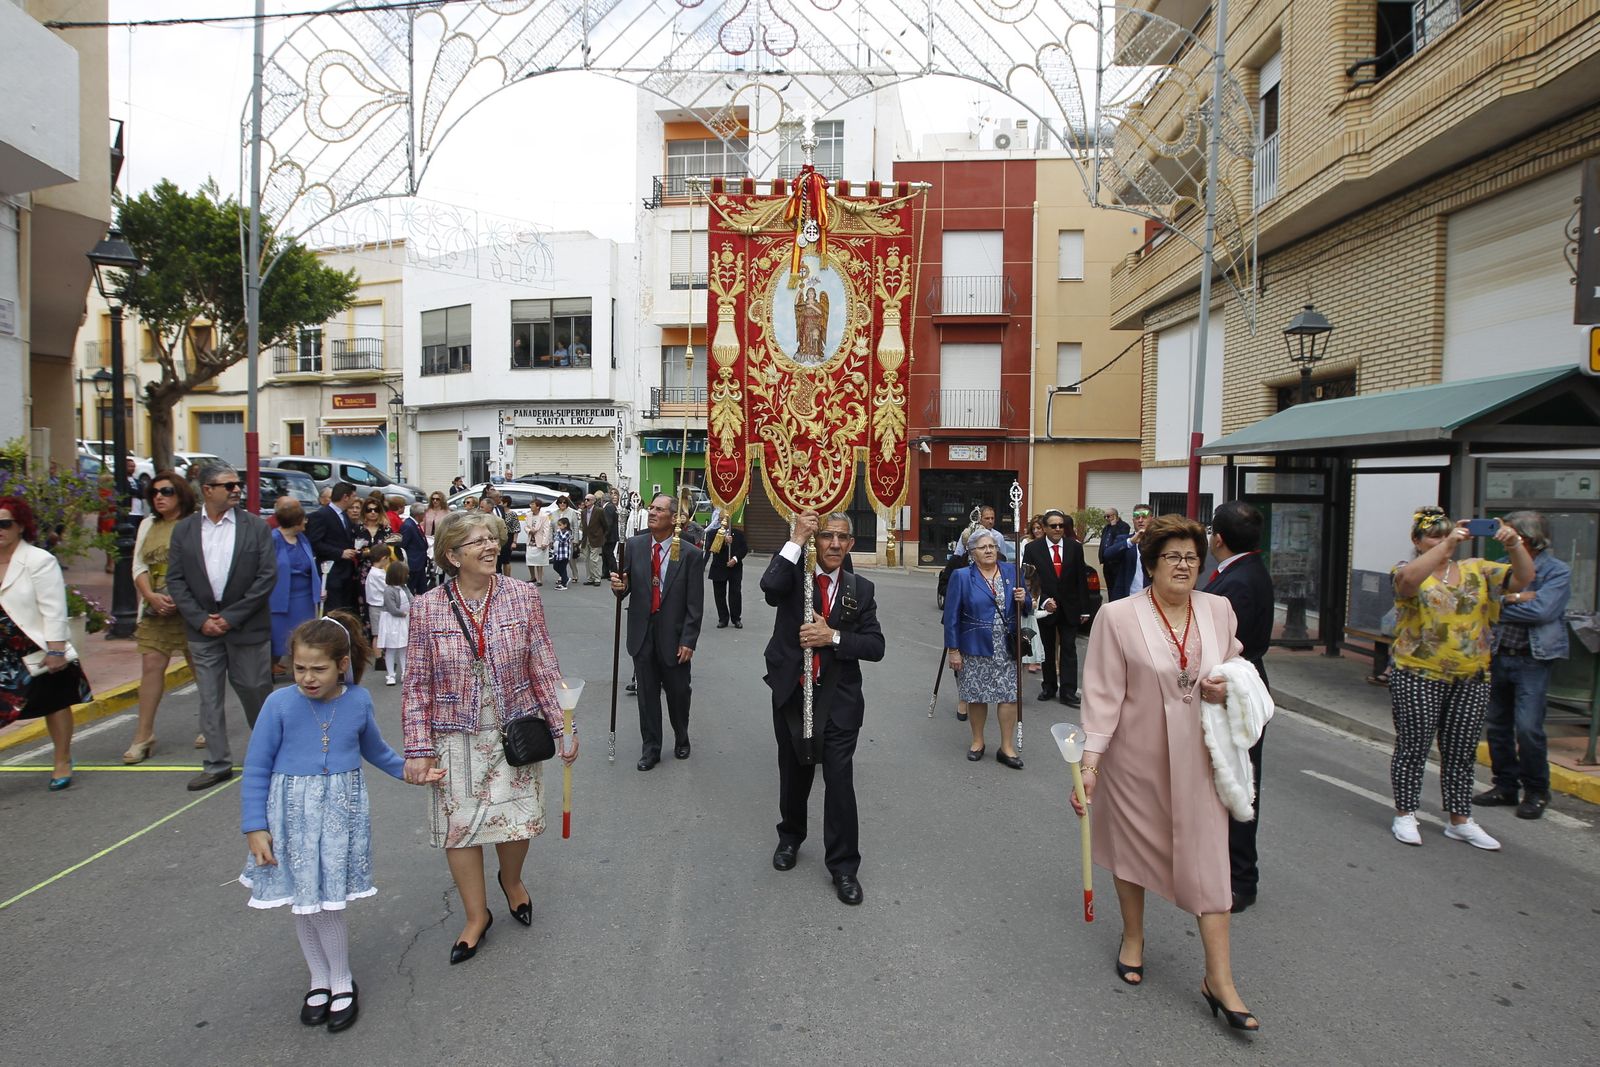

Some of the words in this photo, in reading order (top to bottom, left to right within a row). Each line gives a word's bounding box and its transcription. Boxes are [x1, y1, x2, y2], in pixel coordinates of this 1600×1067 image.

[513, 409, 615, 417] PANADERIA-SUPERMERCADO
[536, 417, 565, 425] SANTA
[571, 417, 594, 425] CRUZ
